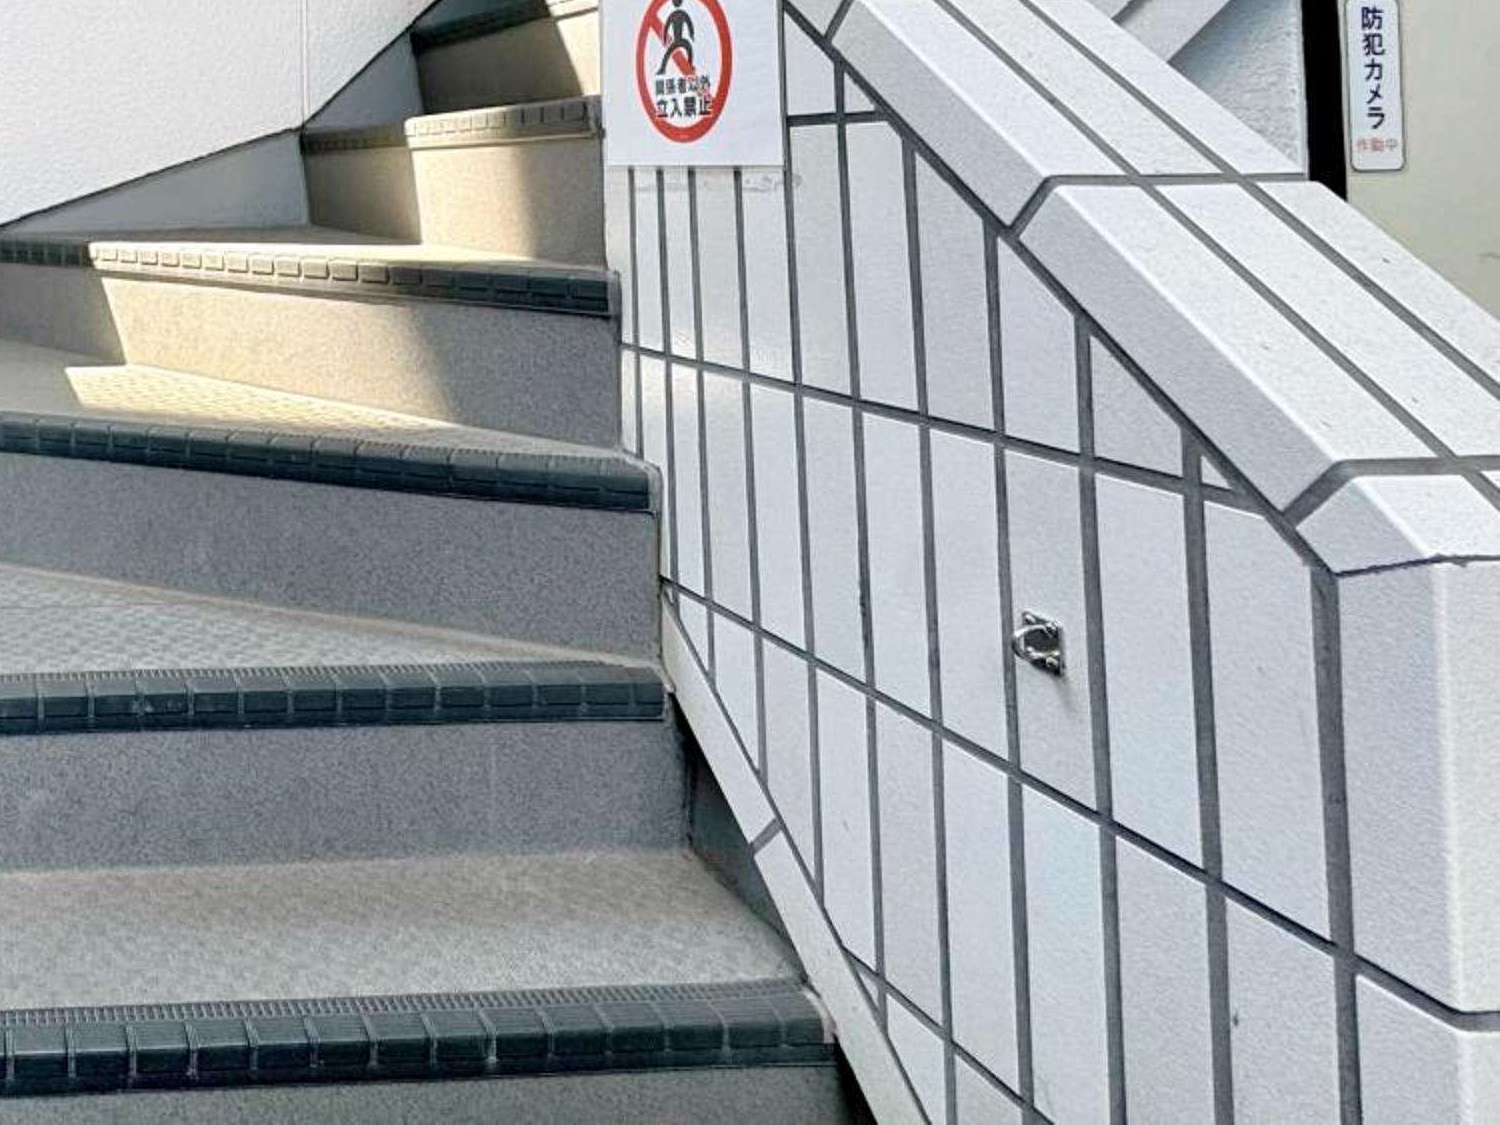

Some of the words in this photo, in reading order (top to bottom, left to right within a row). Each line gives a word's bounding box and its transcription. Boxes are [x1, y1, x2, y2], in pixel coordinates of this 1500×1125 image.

[1361, 5, 1386, 130] 防犯カメラ
[656, 96, 714, 118] 立入禁止
